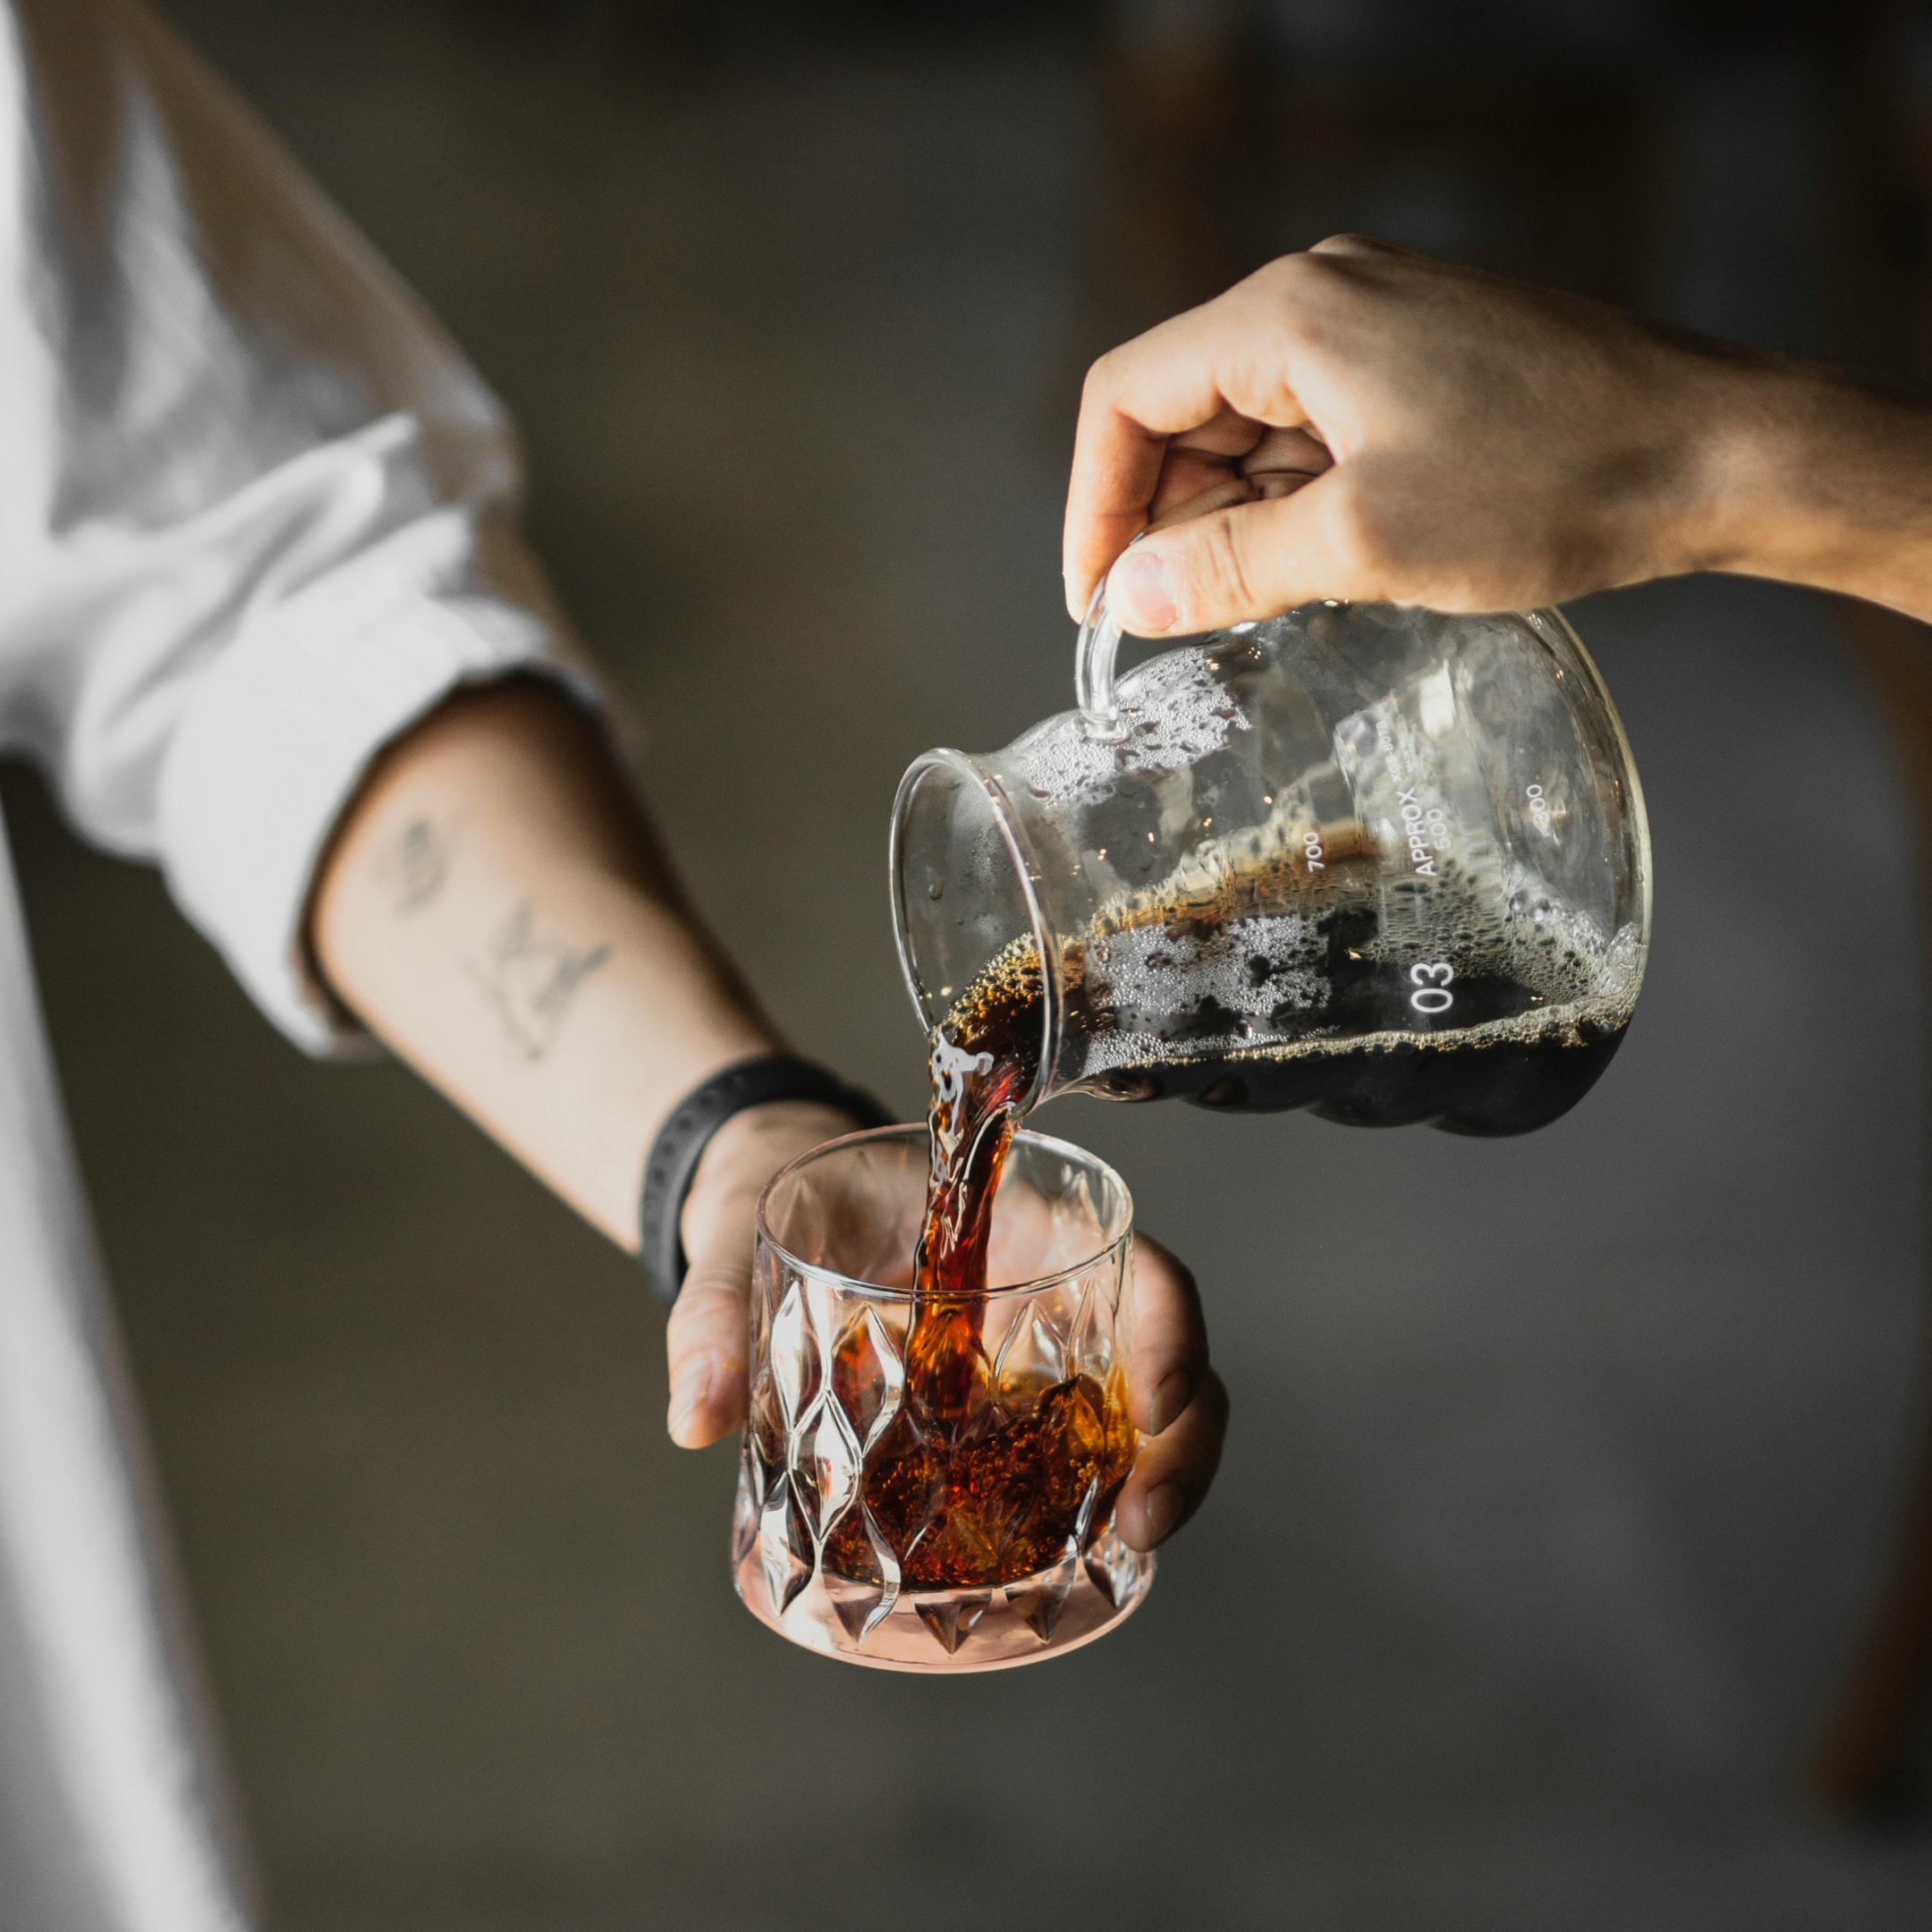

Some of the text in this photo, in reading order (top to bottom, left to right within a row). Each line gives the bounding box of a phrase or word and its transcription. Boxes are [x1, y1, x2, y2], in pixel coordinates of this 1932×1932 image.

[1302, 831, 1326, 873] 700
[1396, 787, 1437, 877] APPROX
[1426, 808, 1452, 851] 500
[1410, 962, 1454, 1013] 03
